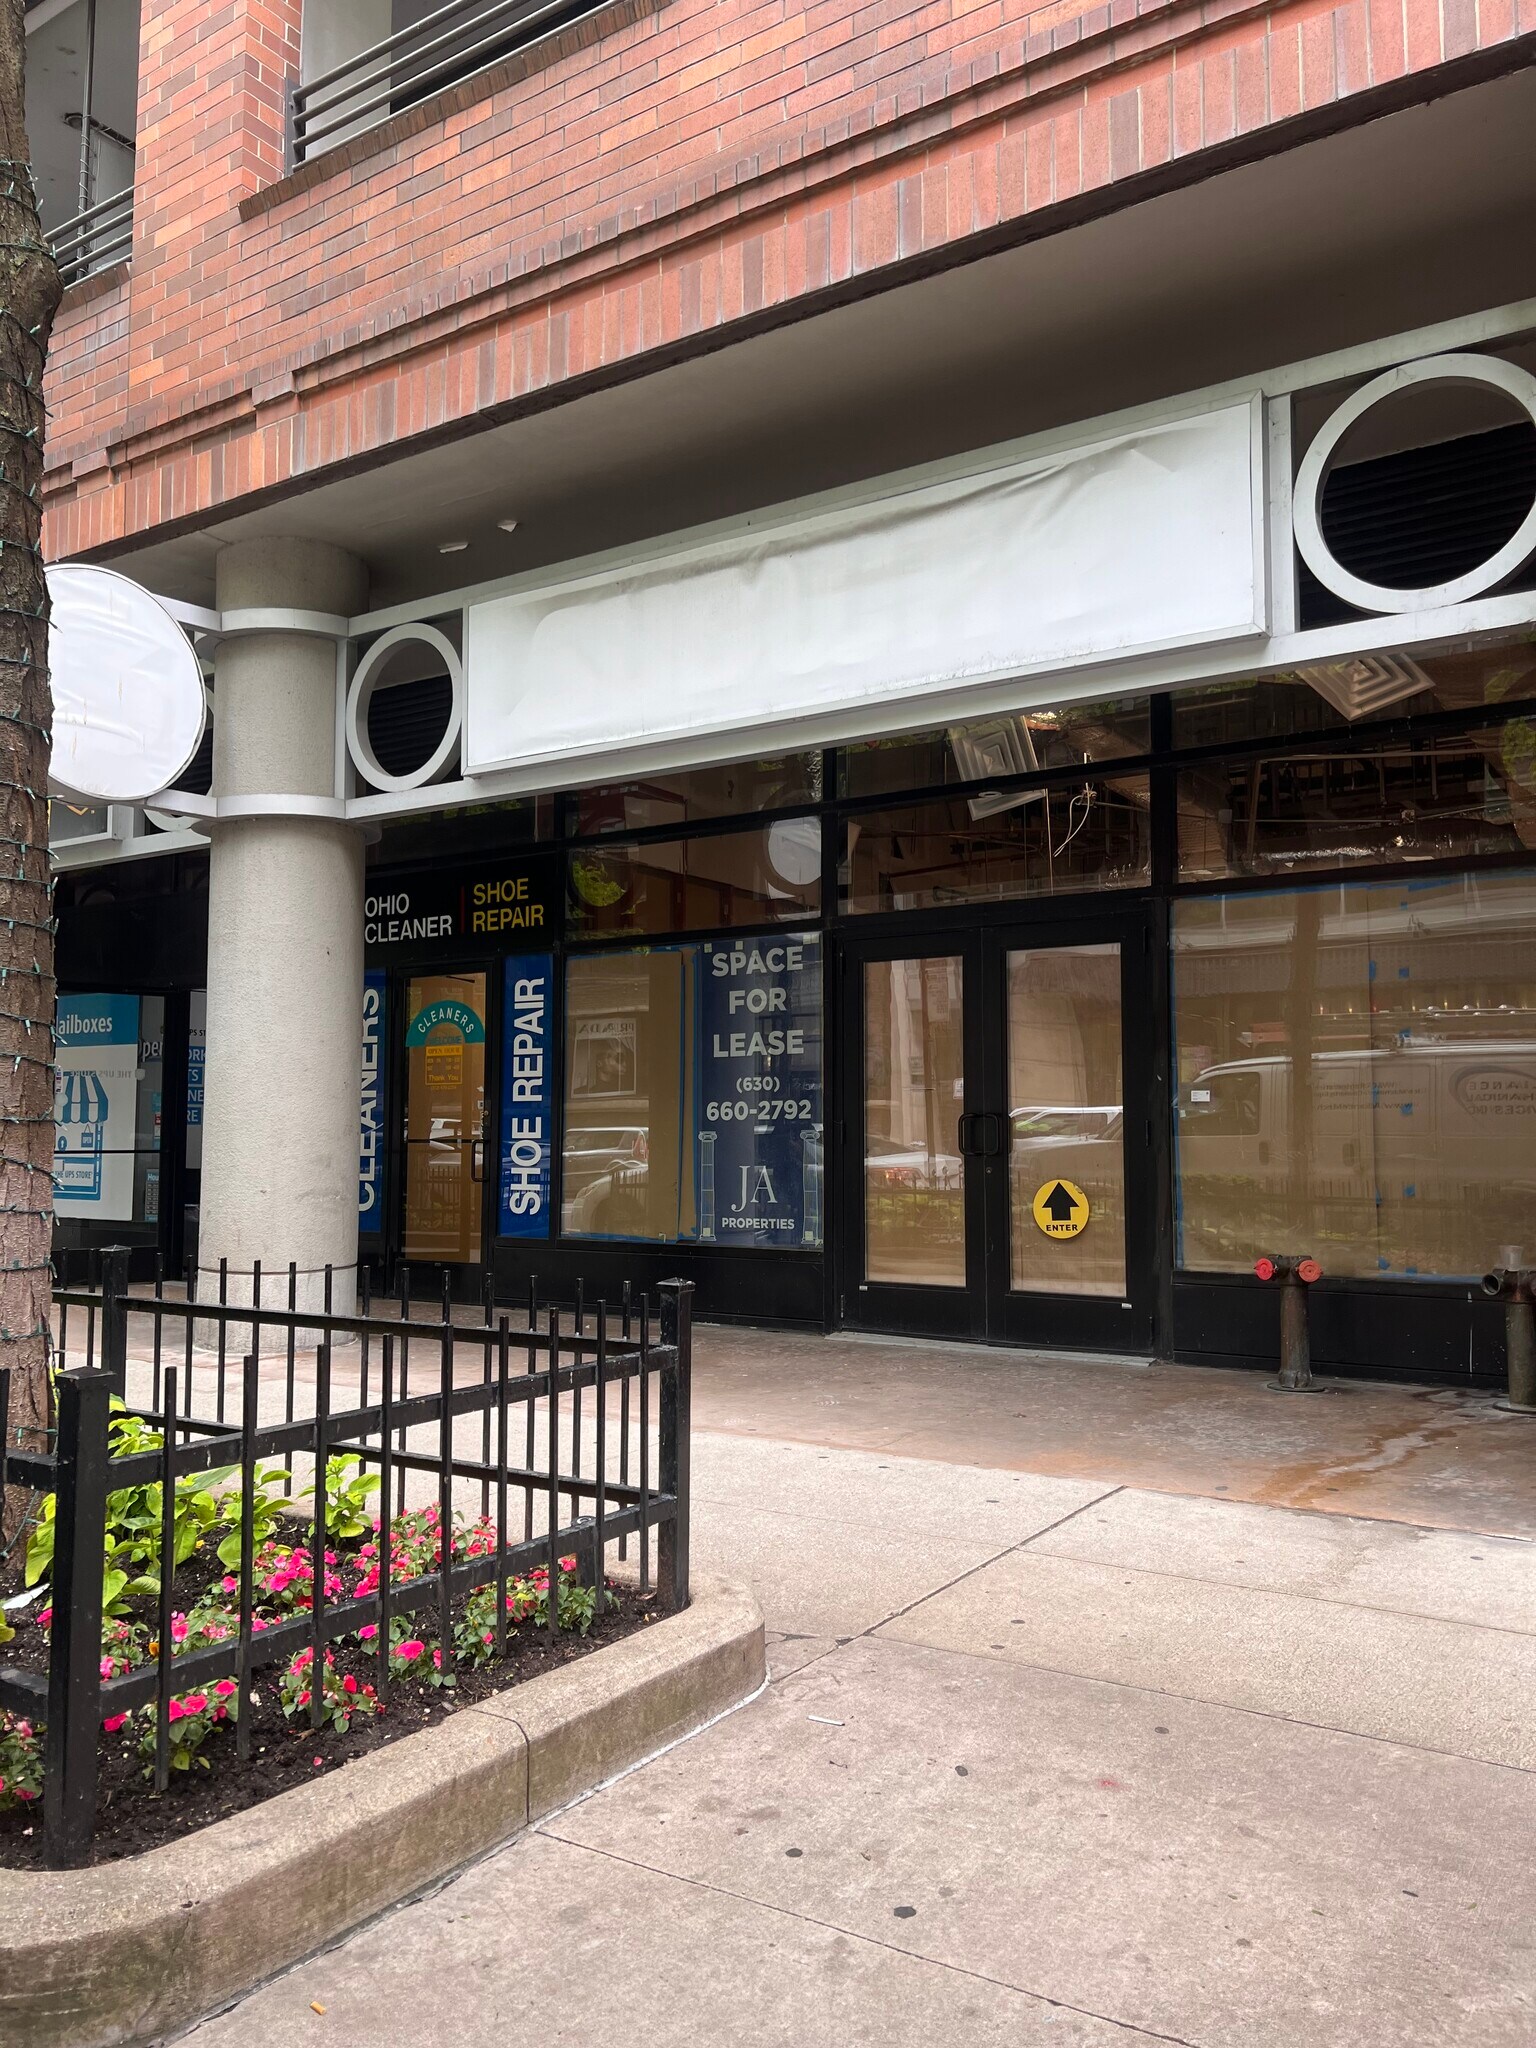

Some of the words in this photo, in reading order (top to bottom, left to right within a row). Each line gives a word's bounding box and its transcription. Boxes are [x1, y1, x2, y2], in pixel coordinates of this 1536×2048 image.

[365, 893, 410, 917] OHIO
[473, 878, 529, 905] SHOE
[365, 915, 452, 943] CLEANER
[473, 904, 544, 932] REPAIR
[712, 945, 803, 977] SPACE
[729, 987, 787, 1015] FOR
[57, 1015, 113, 1034] ailboxes
[418, 1007, 474, 1033] CLEANERS
[512, 977, 545, 1102] REPAIR
[713, 1029, 804, 1058] LEASE
[736, 1076, 781, 1093] (630)
[706, 1099, 812, 1121] 660-2792
[65, 1170, 74, 1178] UPS
[509, 1116, 541, 1216] SHOE
[731, 1165, 778, 1212] JA
[721, 1217, 795, 1230] PROPERTIES
